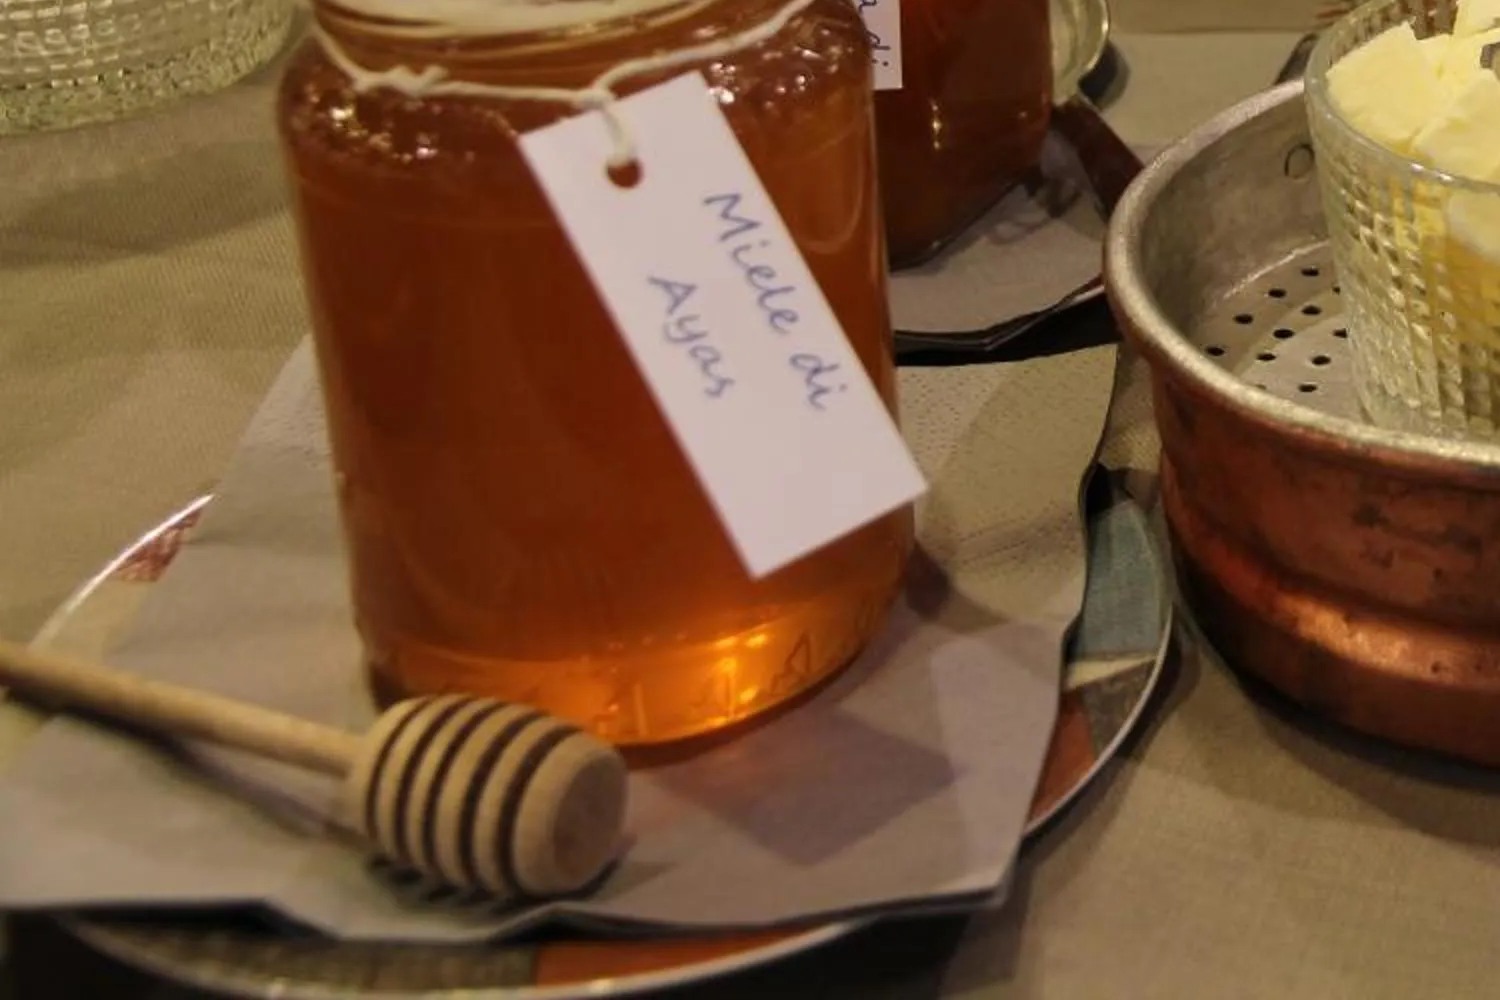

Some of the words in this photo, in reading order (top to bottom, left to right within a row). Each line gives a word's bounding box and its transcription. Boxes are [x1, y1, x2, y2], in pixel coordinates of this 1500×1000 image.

[646, 272, 738, 401] Ayas
[703, 193, 800, 336] Miele
[788, 350, 849, 412] di
